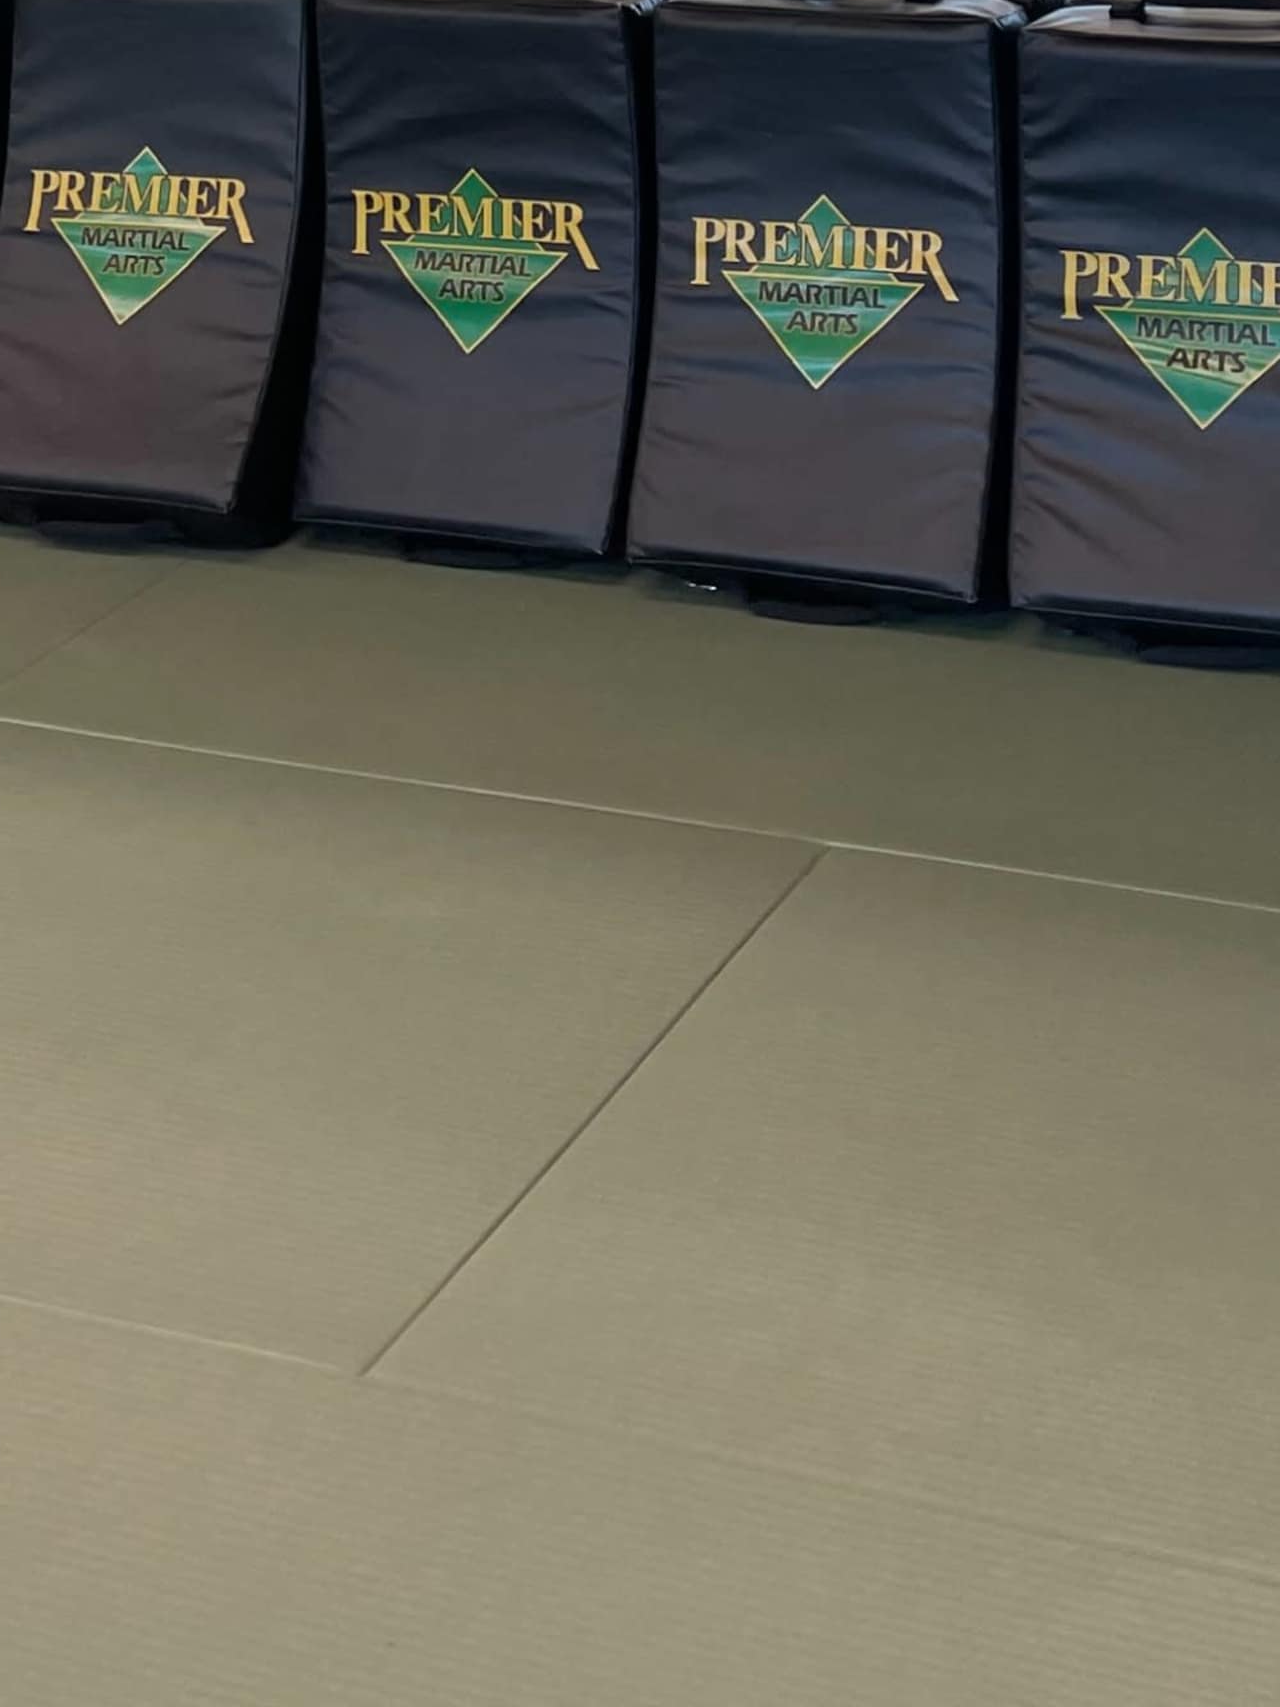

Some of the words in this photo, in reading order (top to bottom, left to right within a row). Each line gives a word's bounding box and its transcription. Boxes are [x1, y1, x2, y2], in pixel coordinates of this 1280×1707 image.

[23, 169, 255, 244] PREMIER
[81, 227, 191, 251] MARTIAL
[351, 189, 601, 271] PREMIER
[102, 254, 166, 276] ARTS
[415, 250, 532, 277] MARTIAL
[689, 217, 960, 303] PREMIER
[438, 279, 505, 302] ARTS
[758, 281, 887, 309] MARTIAL
[786, 310, 859, 335] ARTS
[1136, 315, 1277, 347] MARTIAL
[1166, 348, 1247, 373] ARTS
